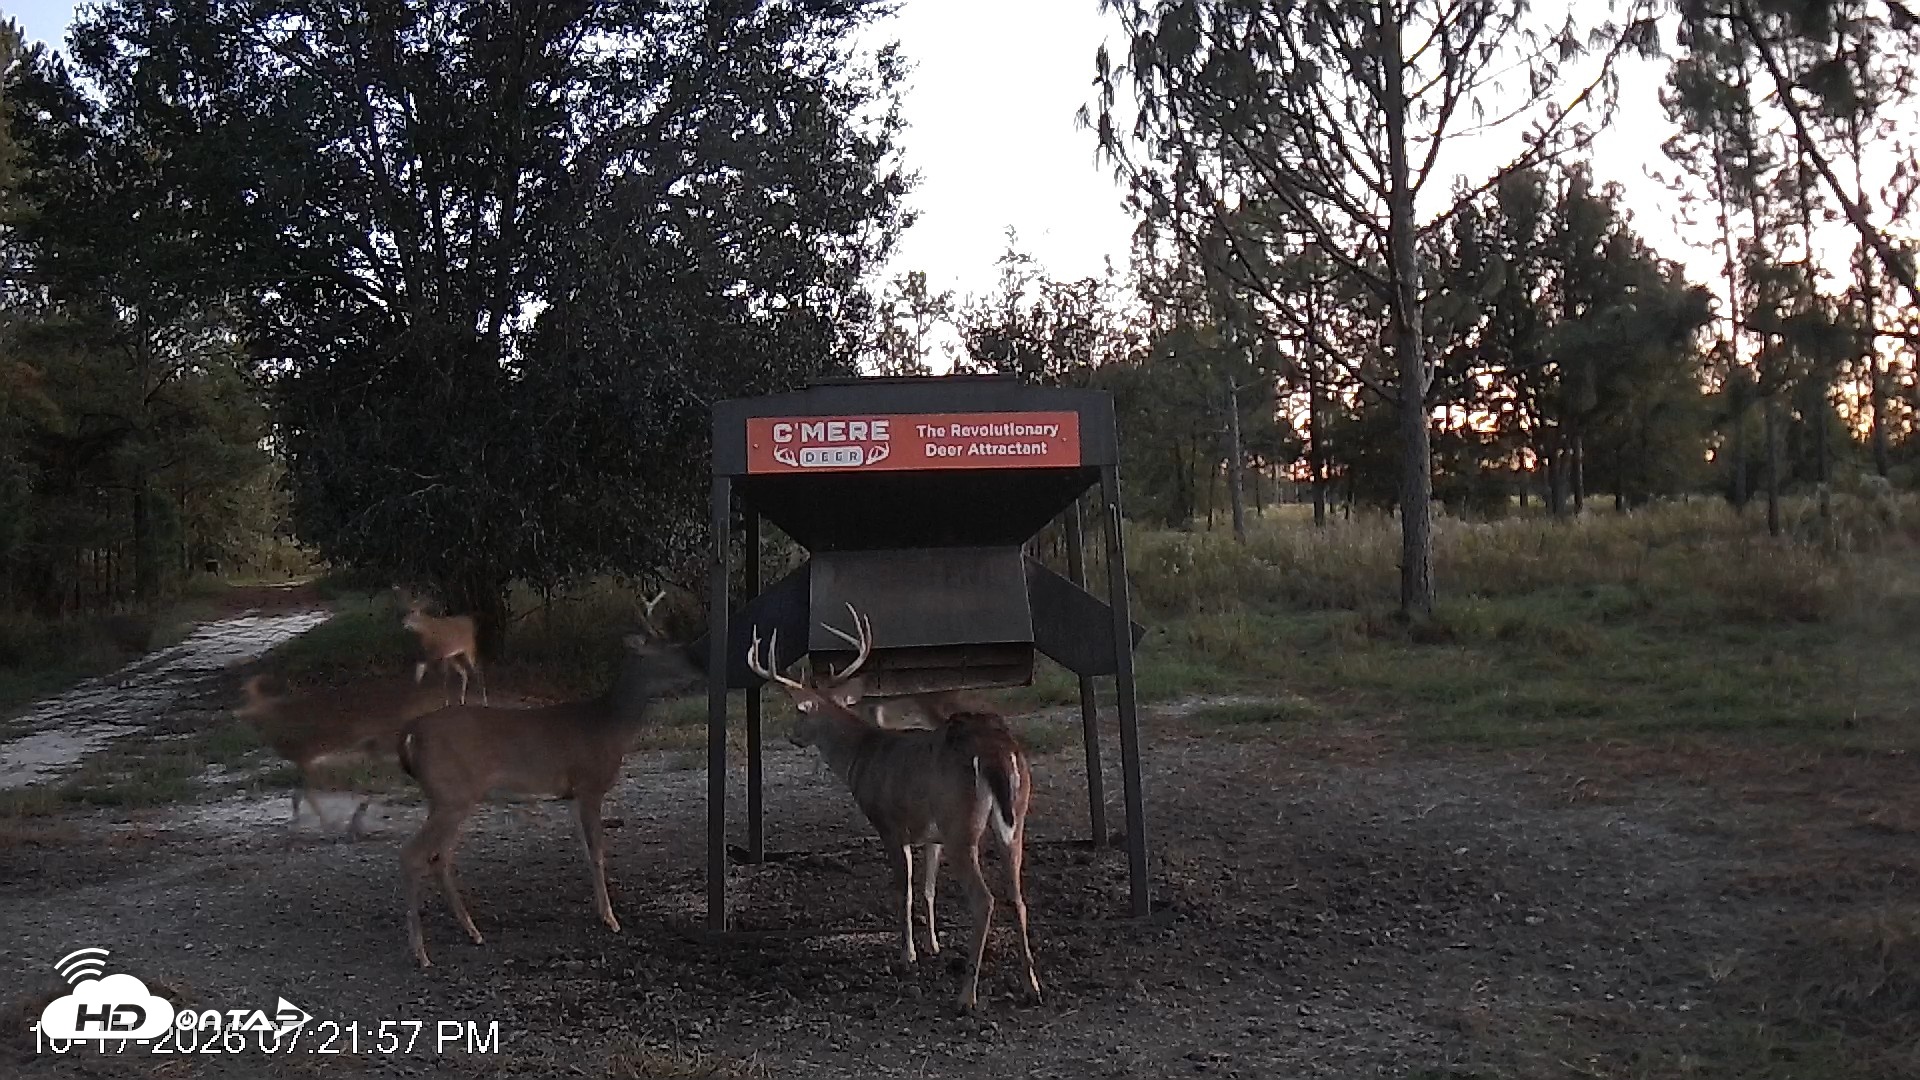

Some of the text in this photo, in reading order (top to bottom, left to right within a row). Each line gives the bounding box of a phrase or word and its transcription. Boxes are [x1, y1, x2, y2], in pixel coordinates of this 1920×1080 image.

[773, 419, 890, 444] C'MERE
[916, 422, 1060, 440] The Revolutionary
[803, 450, 860, 464] DEER
[926, 441, 1049, 457] Deer Attractant
